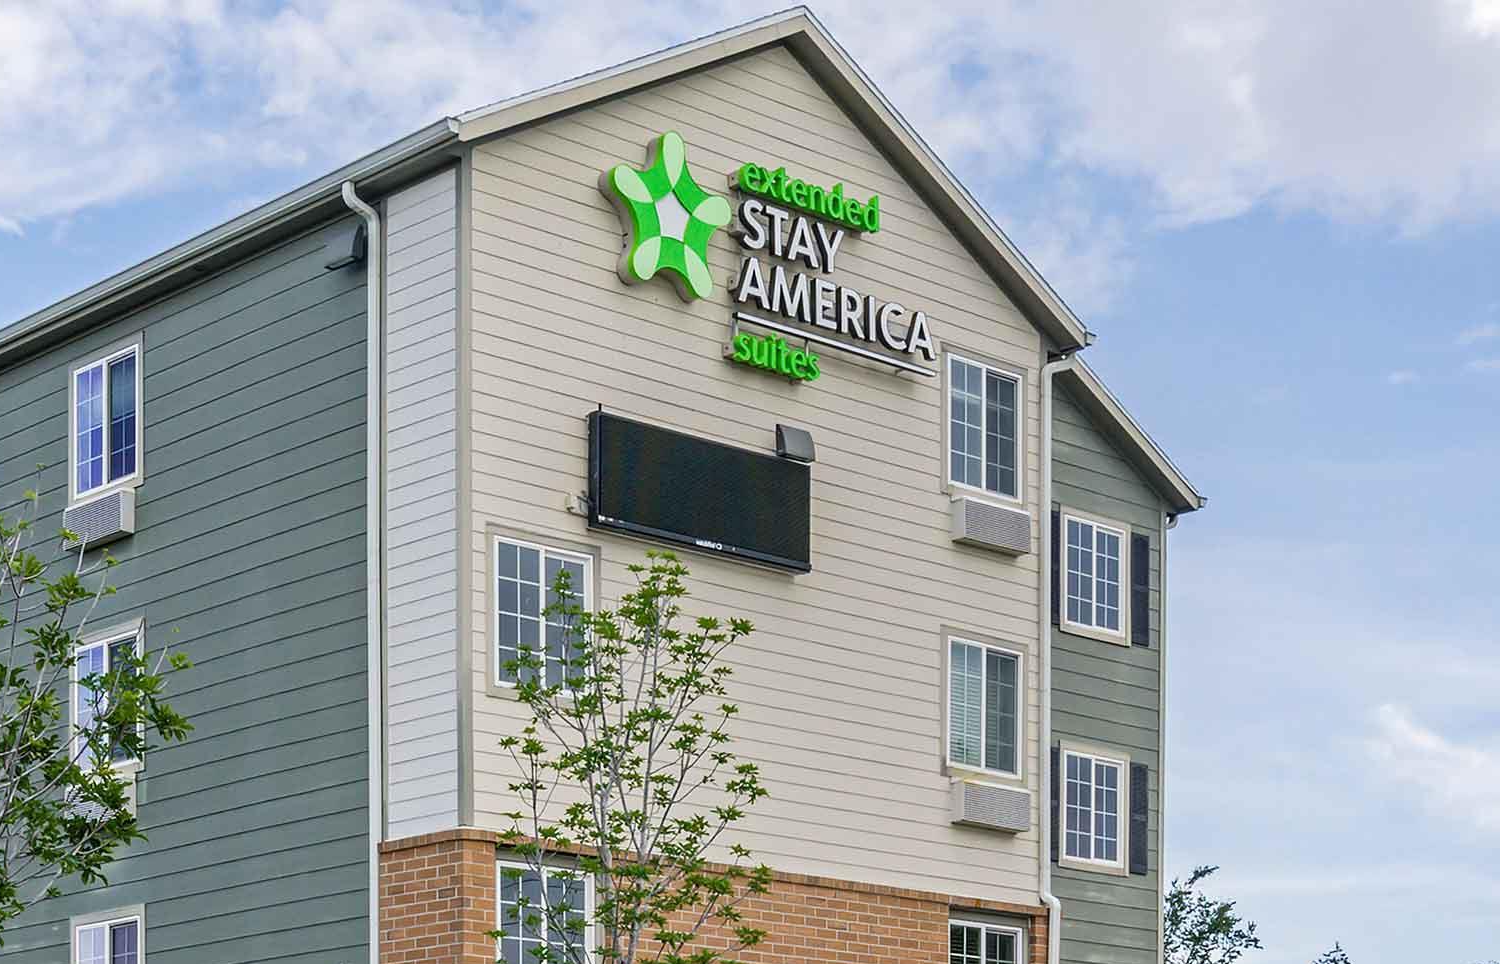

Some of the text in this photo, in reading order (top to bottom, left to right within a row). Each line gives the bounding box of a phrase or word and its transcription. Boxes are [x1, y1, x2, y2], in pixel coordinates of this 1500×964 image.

[739, 162, 881, 233] extended
[740, 199, 845, 274] STAY
[737, 256, 937, 361] AMERICA
[733, 330, 821, 381] suites
